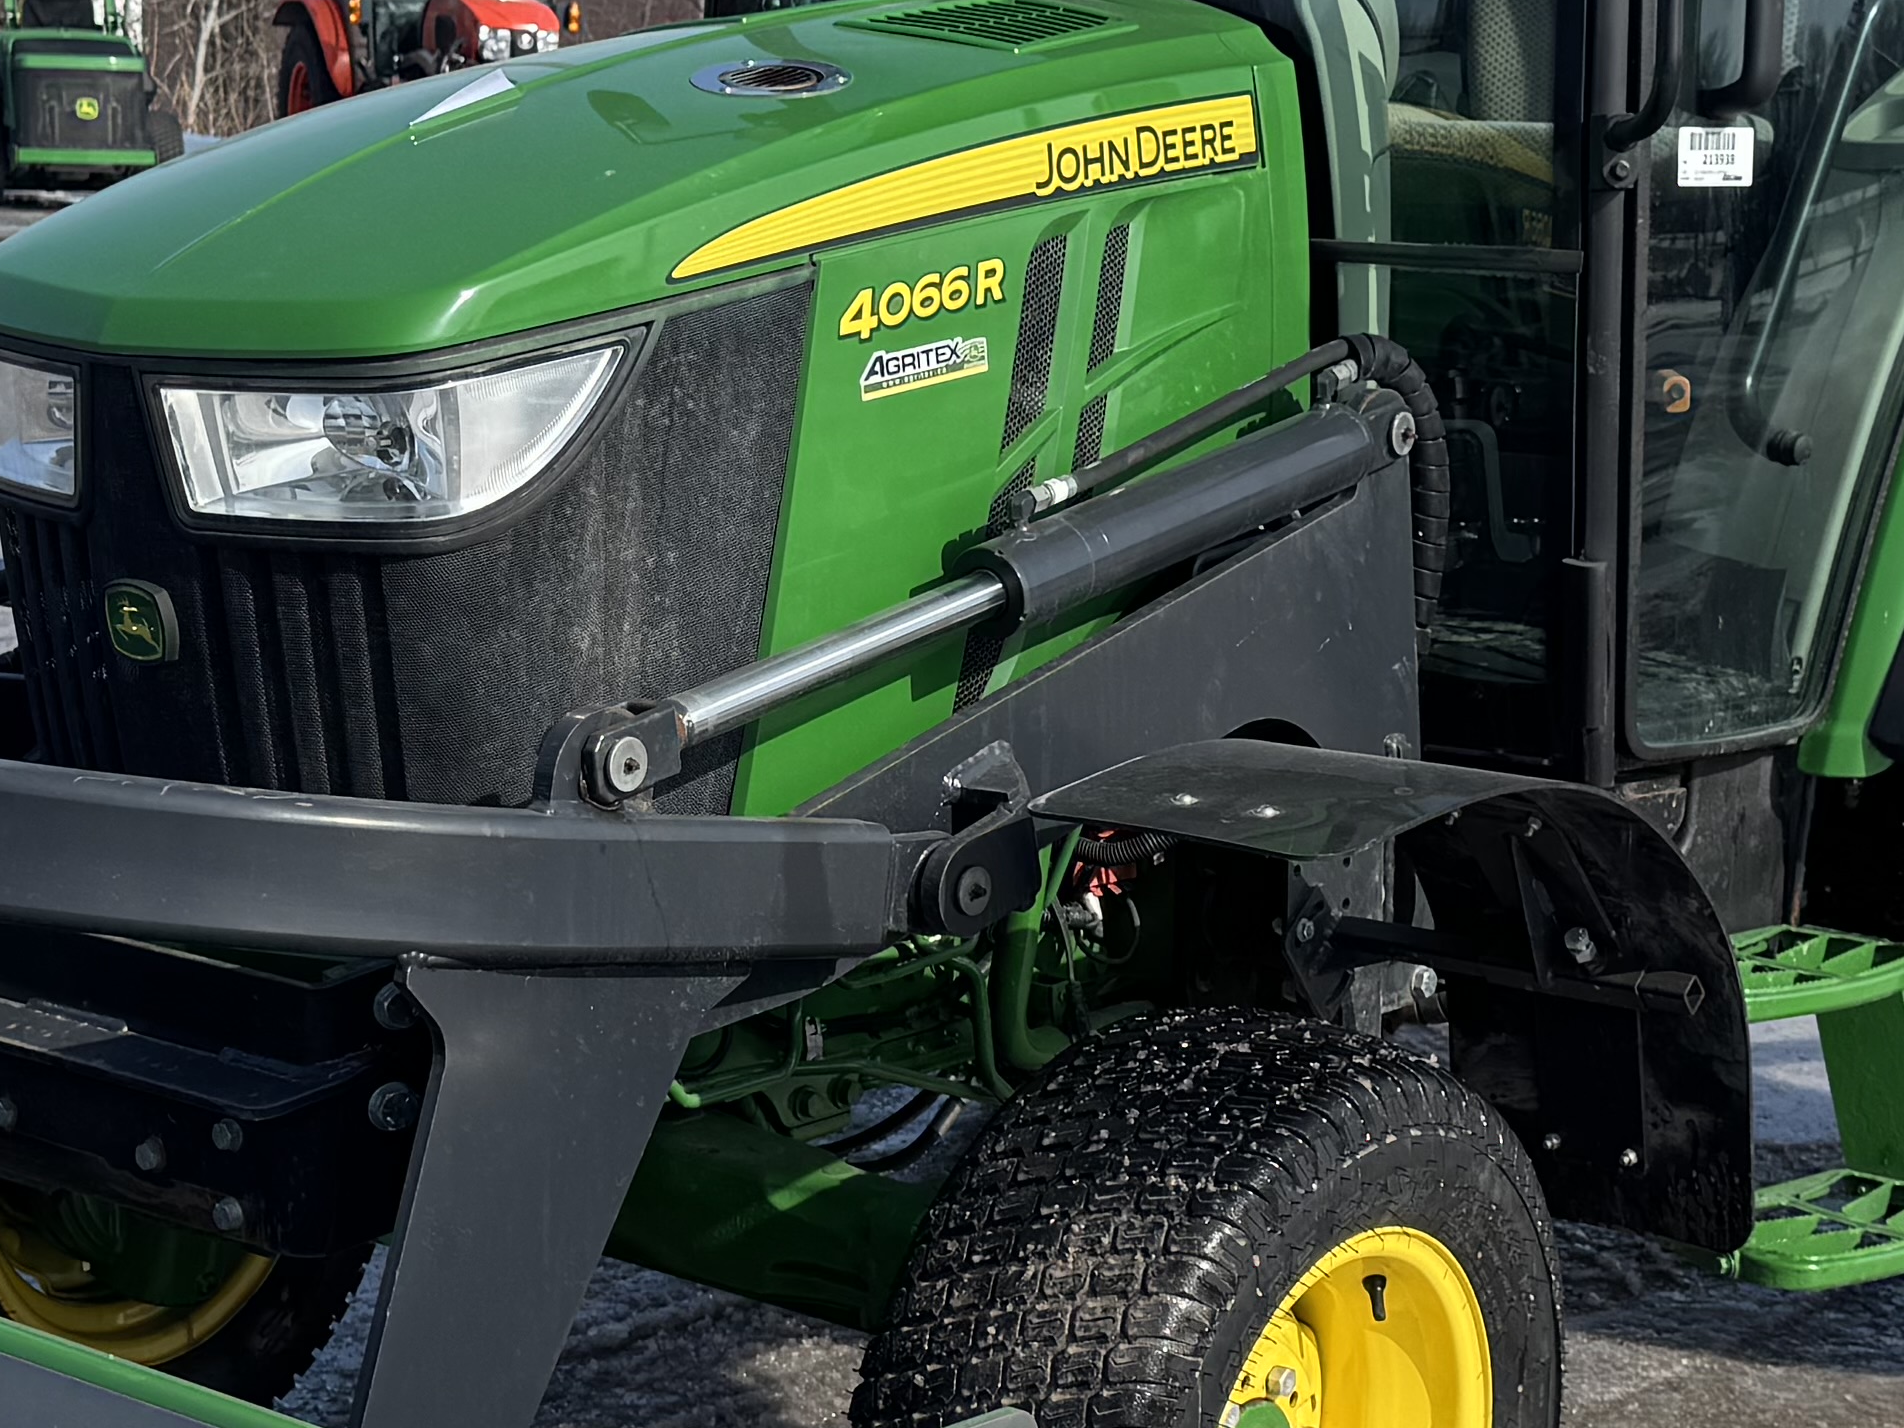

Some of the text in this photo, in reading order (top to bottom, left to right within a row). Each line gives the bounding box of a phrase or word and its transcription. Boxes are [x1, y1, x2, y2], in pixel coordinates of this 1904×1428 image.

[1035, 120, 1237, 190] JOHN DEERE
[863, 341, 961, 382] AGRITEX
